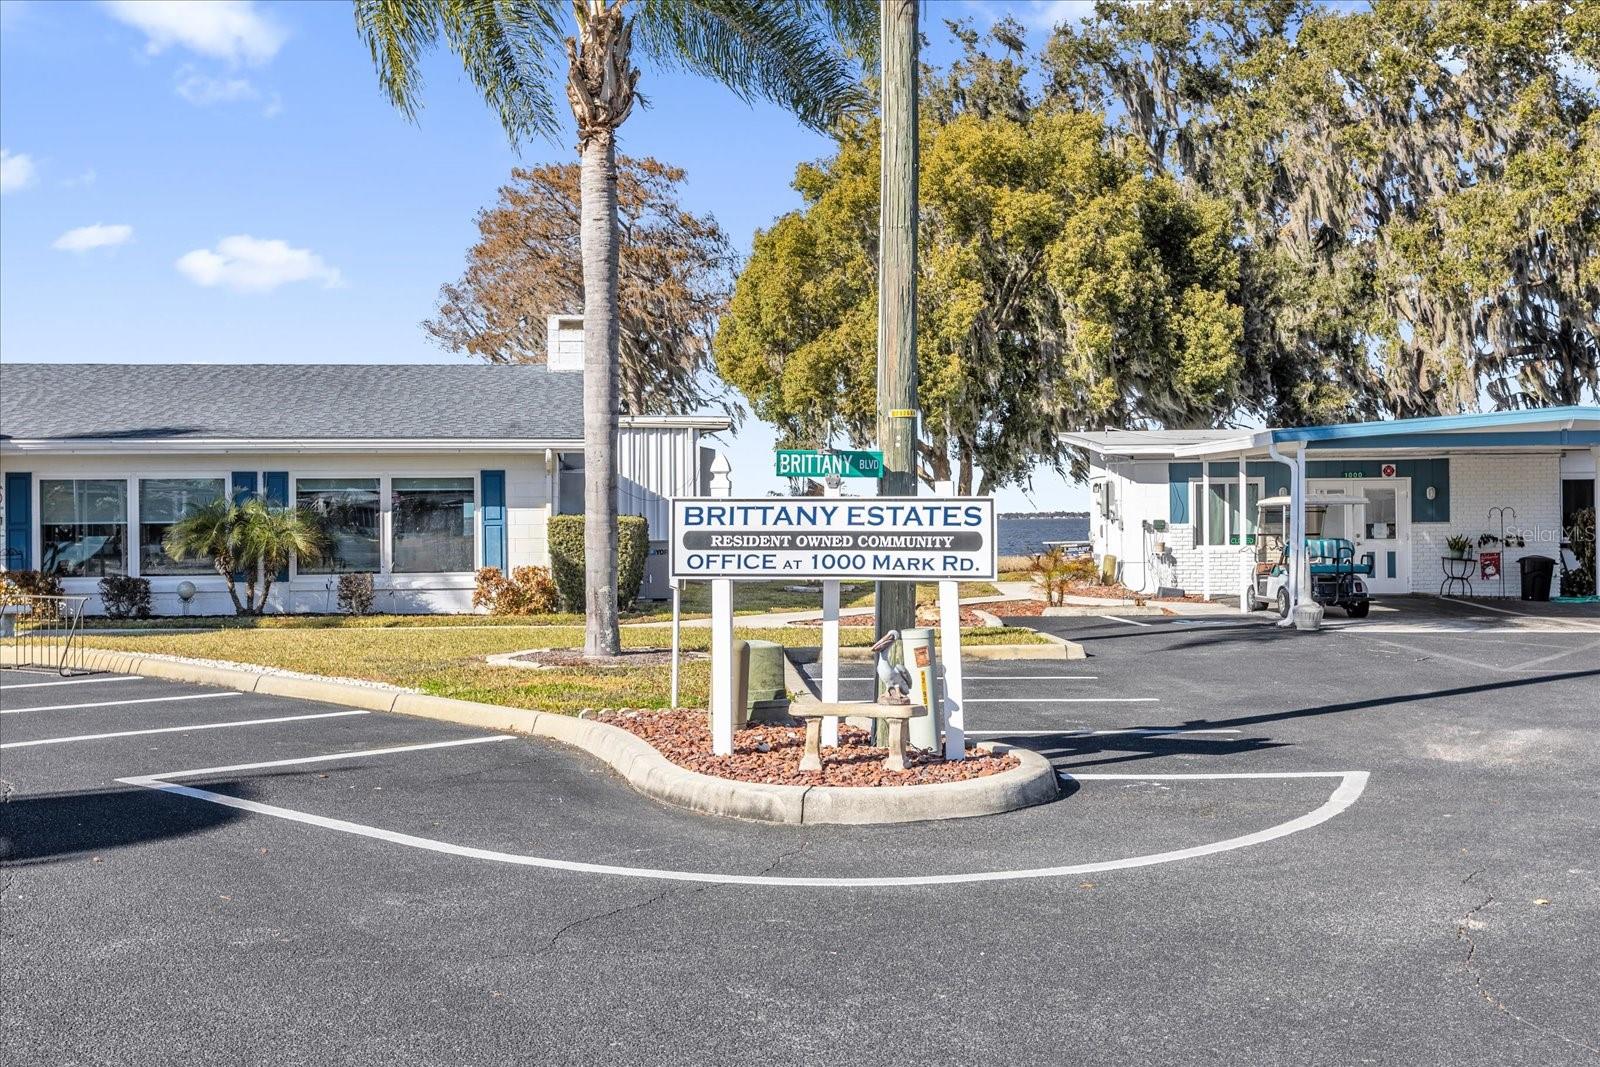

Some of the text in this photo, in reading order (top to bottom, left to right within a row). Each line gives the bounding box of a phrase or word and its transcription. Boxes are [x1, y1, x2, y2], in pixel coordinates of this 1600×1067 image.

[780, 454, 879, 474] BRITTANY BLVD
[684, 506, 982, 527] BRITTANY ESTATES
[711, 535, 955, 548] RESIDENT OWNED COMMUNITY
[687, 554, 777, 570] OFFICE
[812, 554, 866, 570] 1000
